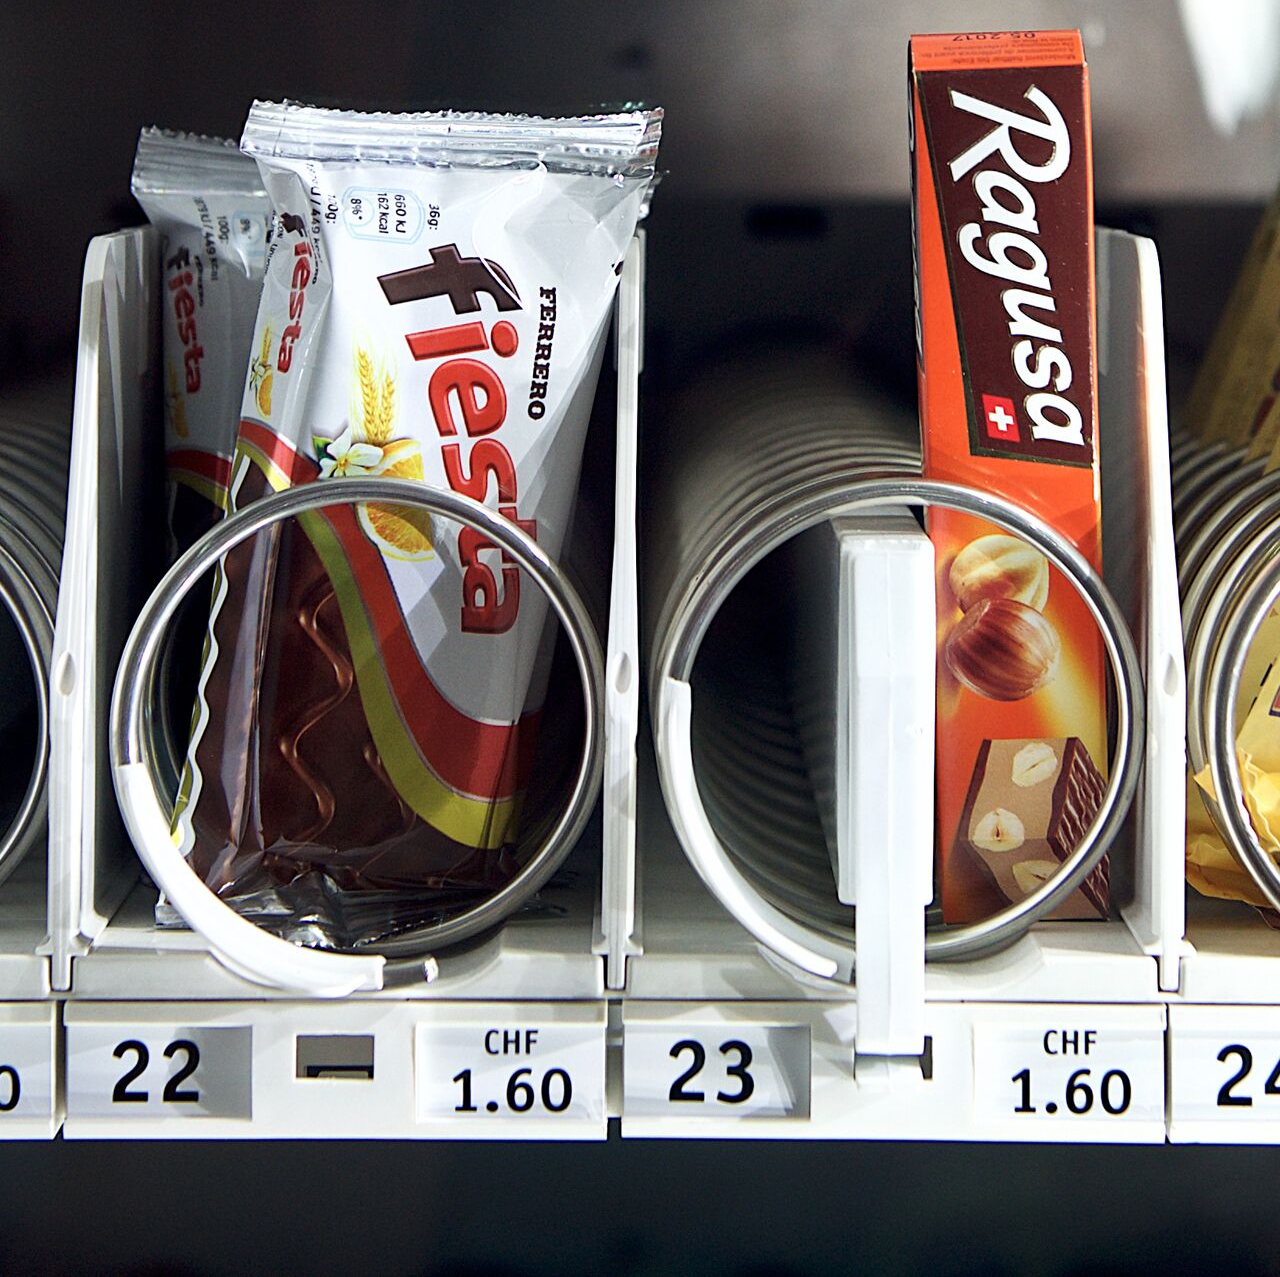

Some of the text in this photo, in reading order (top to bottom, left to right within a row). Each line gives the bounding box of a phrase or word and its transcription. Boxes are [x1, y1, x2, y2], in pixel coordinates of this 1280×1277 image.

[378, 192, 389, 234] 162 kcal
[395, 194, 407, 234] 660 kJ
[947, 83, 1086, 447] Ragusa
[167, 246, 205, 395] fiesta
[528, 287, 557, 420] FERRERO
[375, 242, 538, 635] fiesta
[484, 1029, 539, 1055] CHF
[1043, 1030, 1098, 1056] CHF
[112, 1039, 201, 1103] 22
[452, 1067, 574, 1113] 1.60
[668, 1039, 755, 1104] 23
[1011, 1068, 1132, 1115] 1.60
